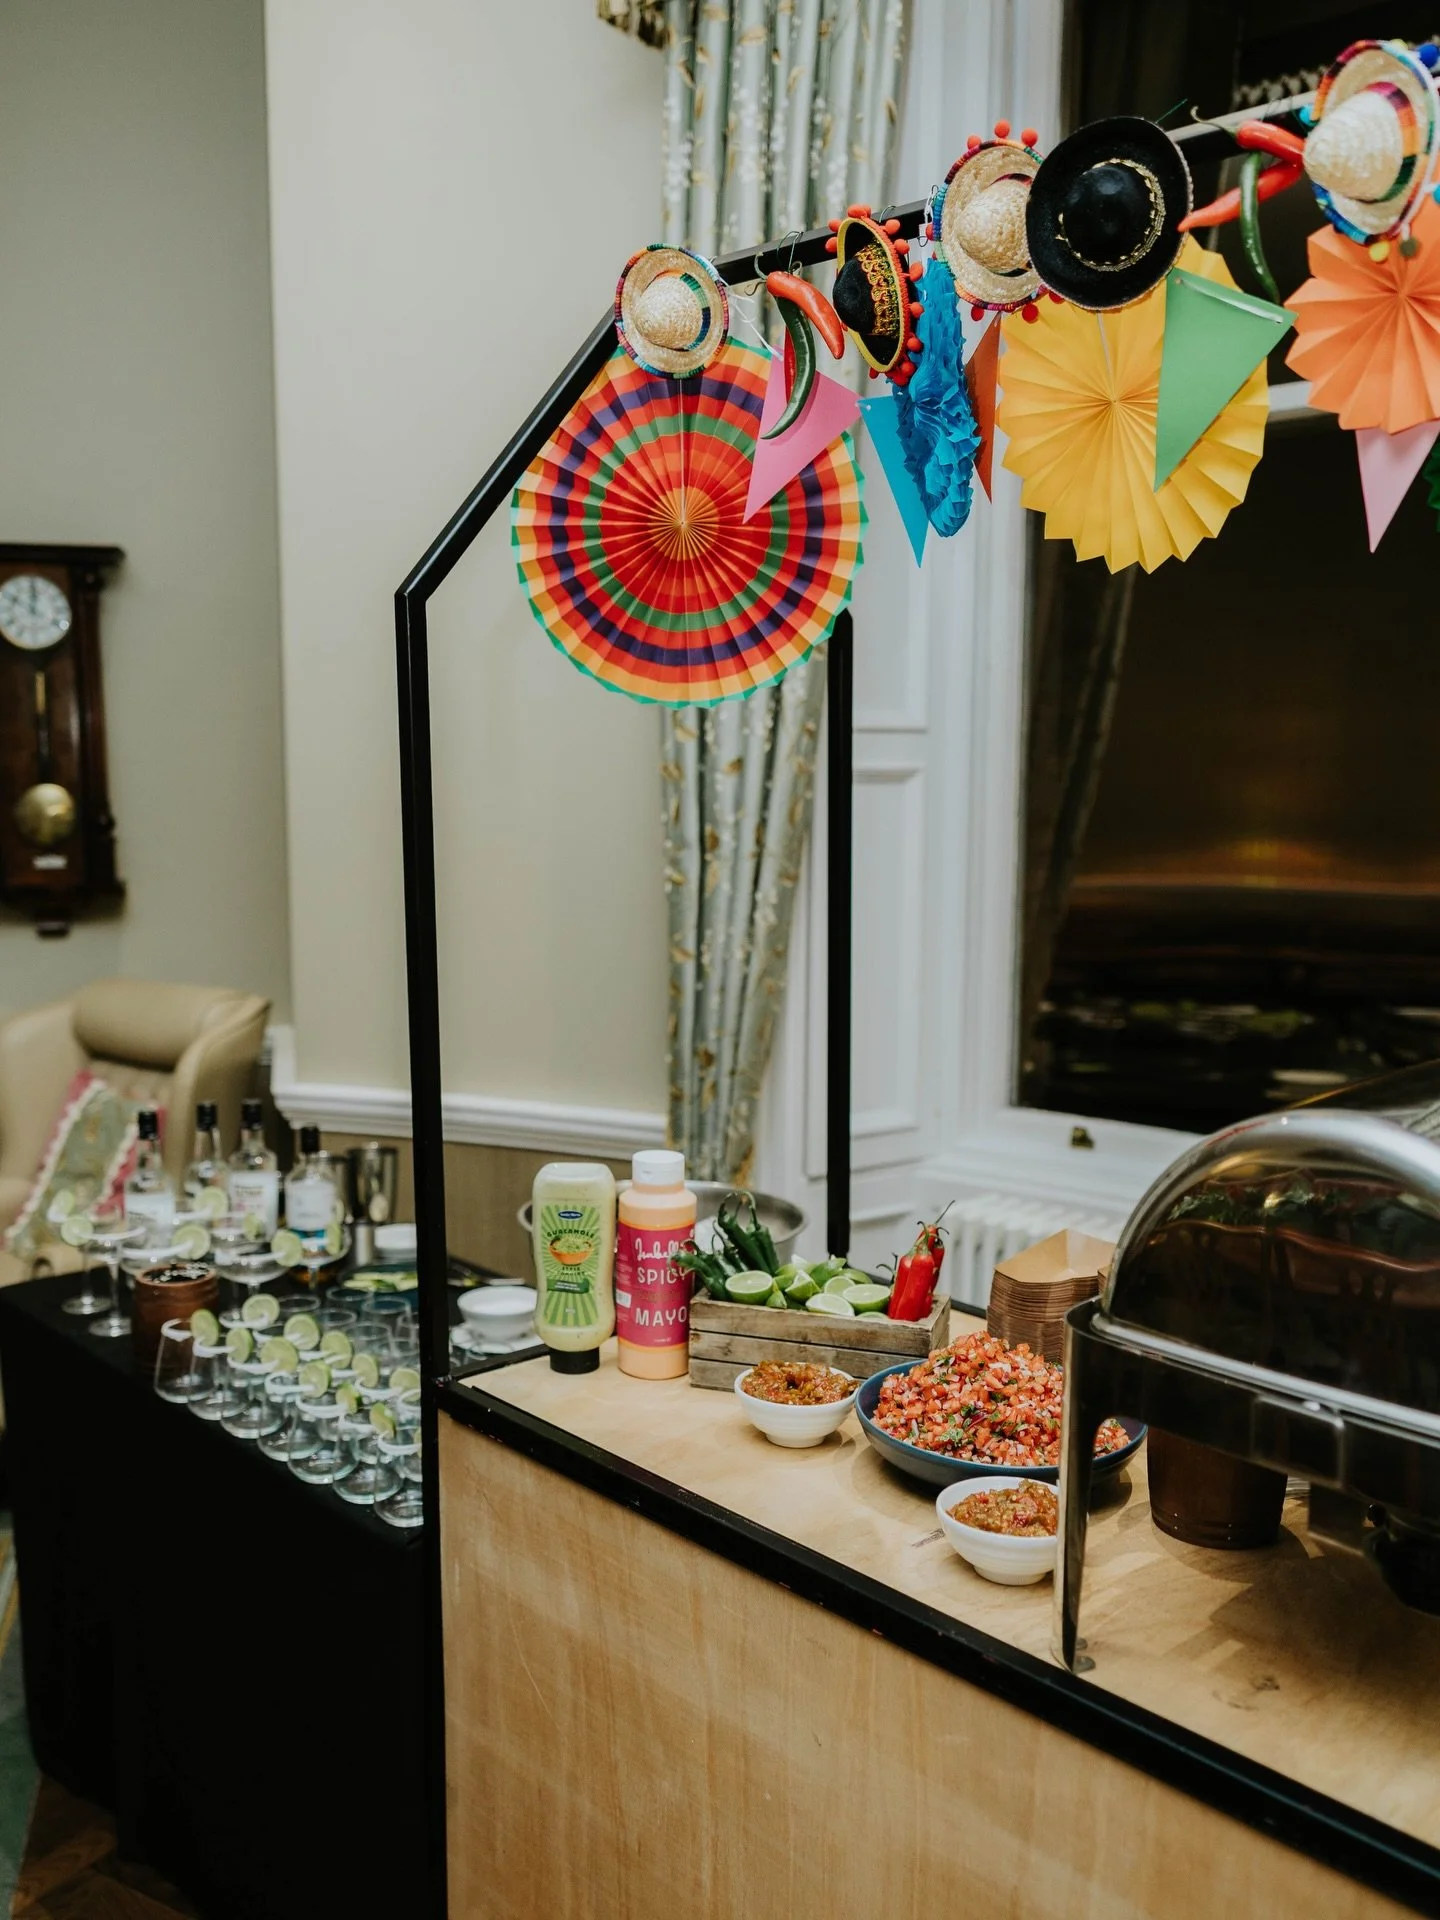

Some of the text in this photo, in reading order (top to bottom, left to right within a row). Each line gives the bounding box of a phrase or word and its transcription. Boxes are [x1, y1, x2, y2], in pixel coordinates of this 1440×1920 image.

[547, 1228, 594, 1239] GUACAMOLE
[637, 1267, 689, 1285] SPICY
[636, 1306, 687, 1327] MAYO
